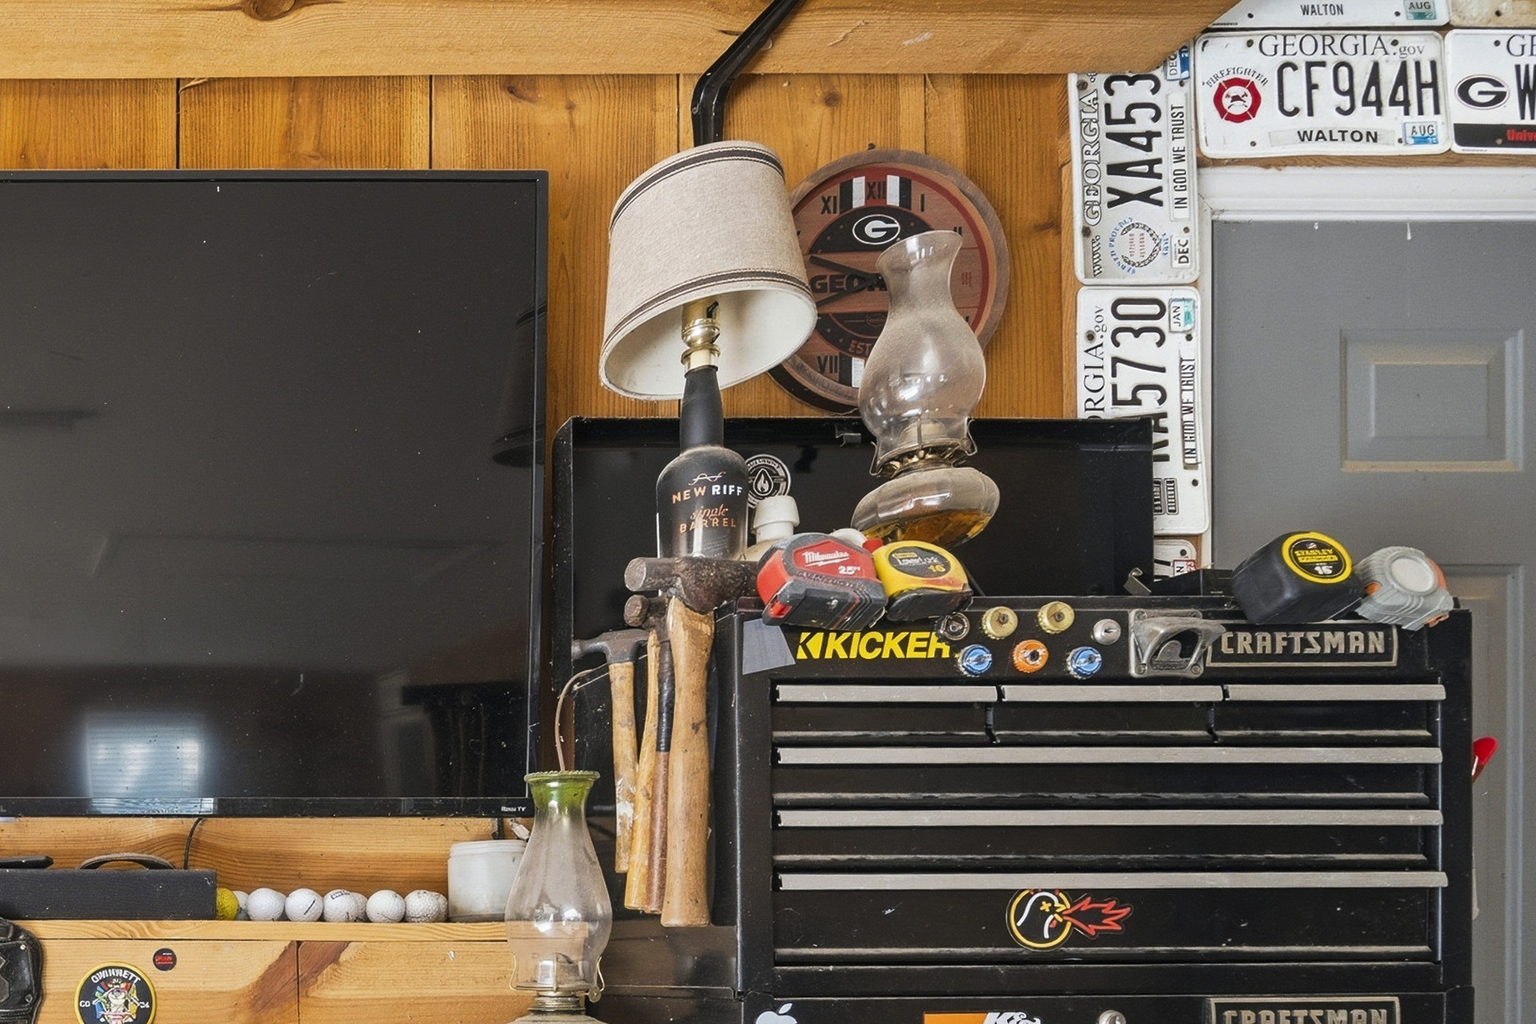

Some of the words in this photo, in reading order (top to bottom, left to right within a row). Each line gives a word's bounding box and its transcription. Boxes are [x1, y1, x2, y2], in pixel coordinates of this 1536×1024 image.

[1300, 4, 1344, 16] WALTON
[1276, 60, 1441, 117] CF944H
[1170, 103, 1185, 136] TRUST
[1297, 129, 1379, 144] WALTON
[1410, 124, 1435, 136] AUG
[1104, 73, 1163, 209] XA453
[1172, 146, 1187, 164] WE
[1173, 169, 1188, 192] GOD
[1174, 197, 1188, 209] IN
[1177, 239, 1190, 265] DEC
[672, 487, 707, 504] NEW
[711, 484, 744, 497] RIFF
[689, 503, 729, 523] single
[679, 517, 737, 534] BARREL
[824, 632, 950, 659] KICKER
[1221, 631, 1385, 655] CRAFTSMAN
[90, 968, 141, 984] GWINNETT
